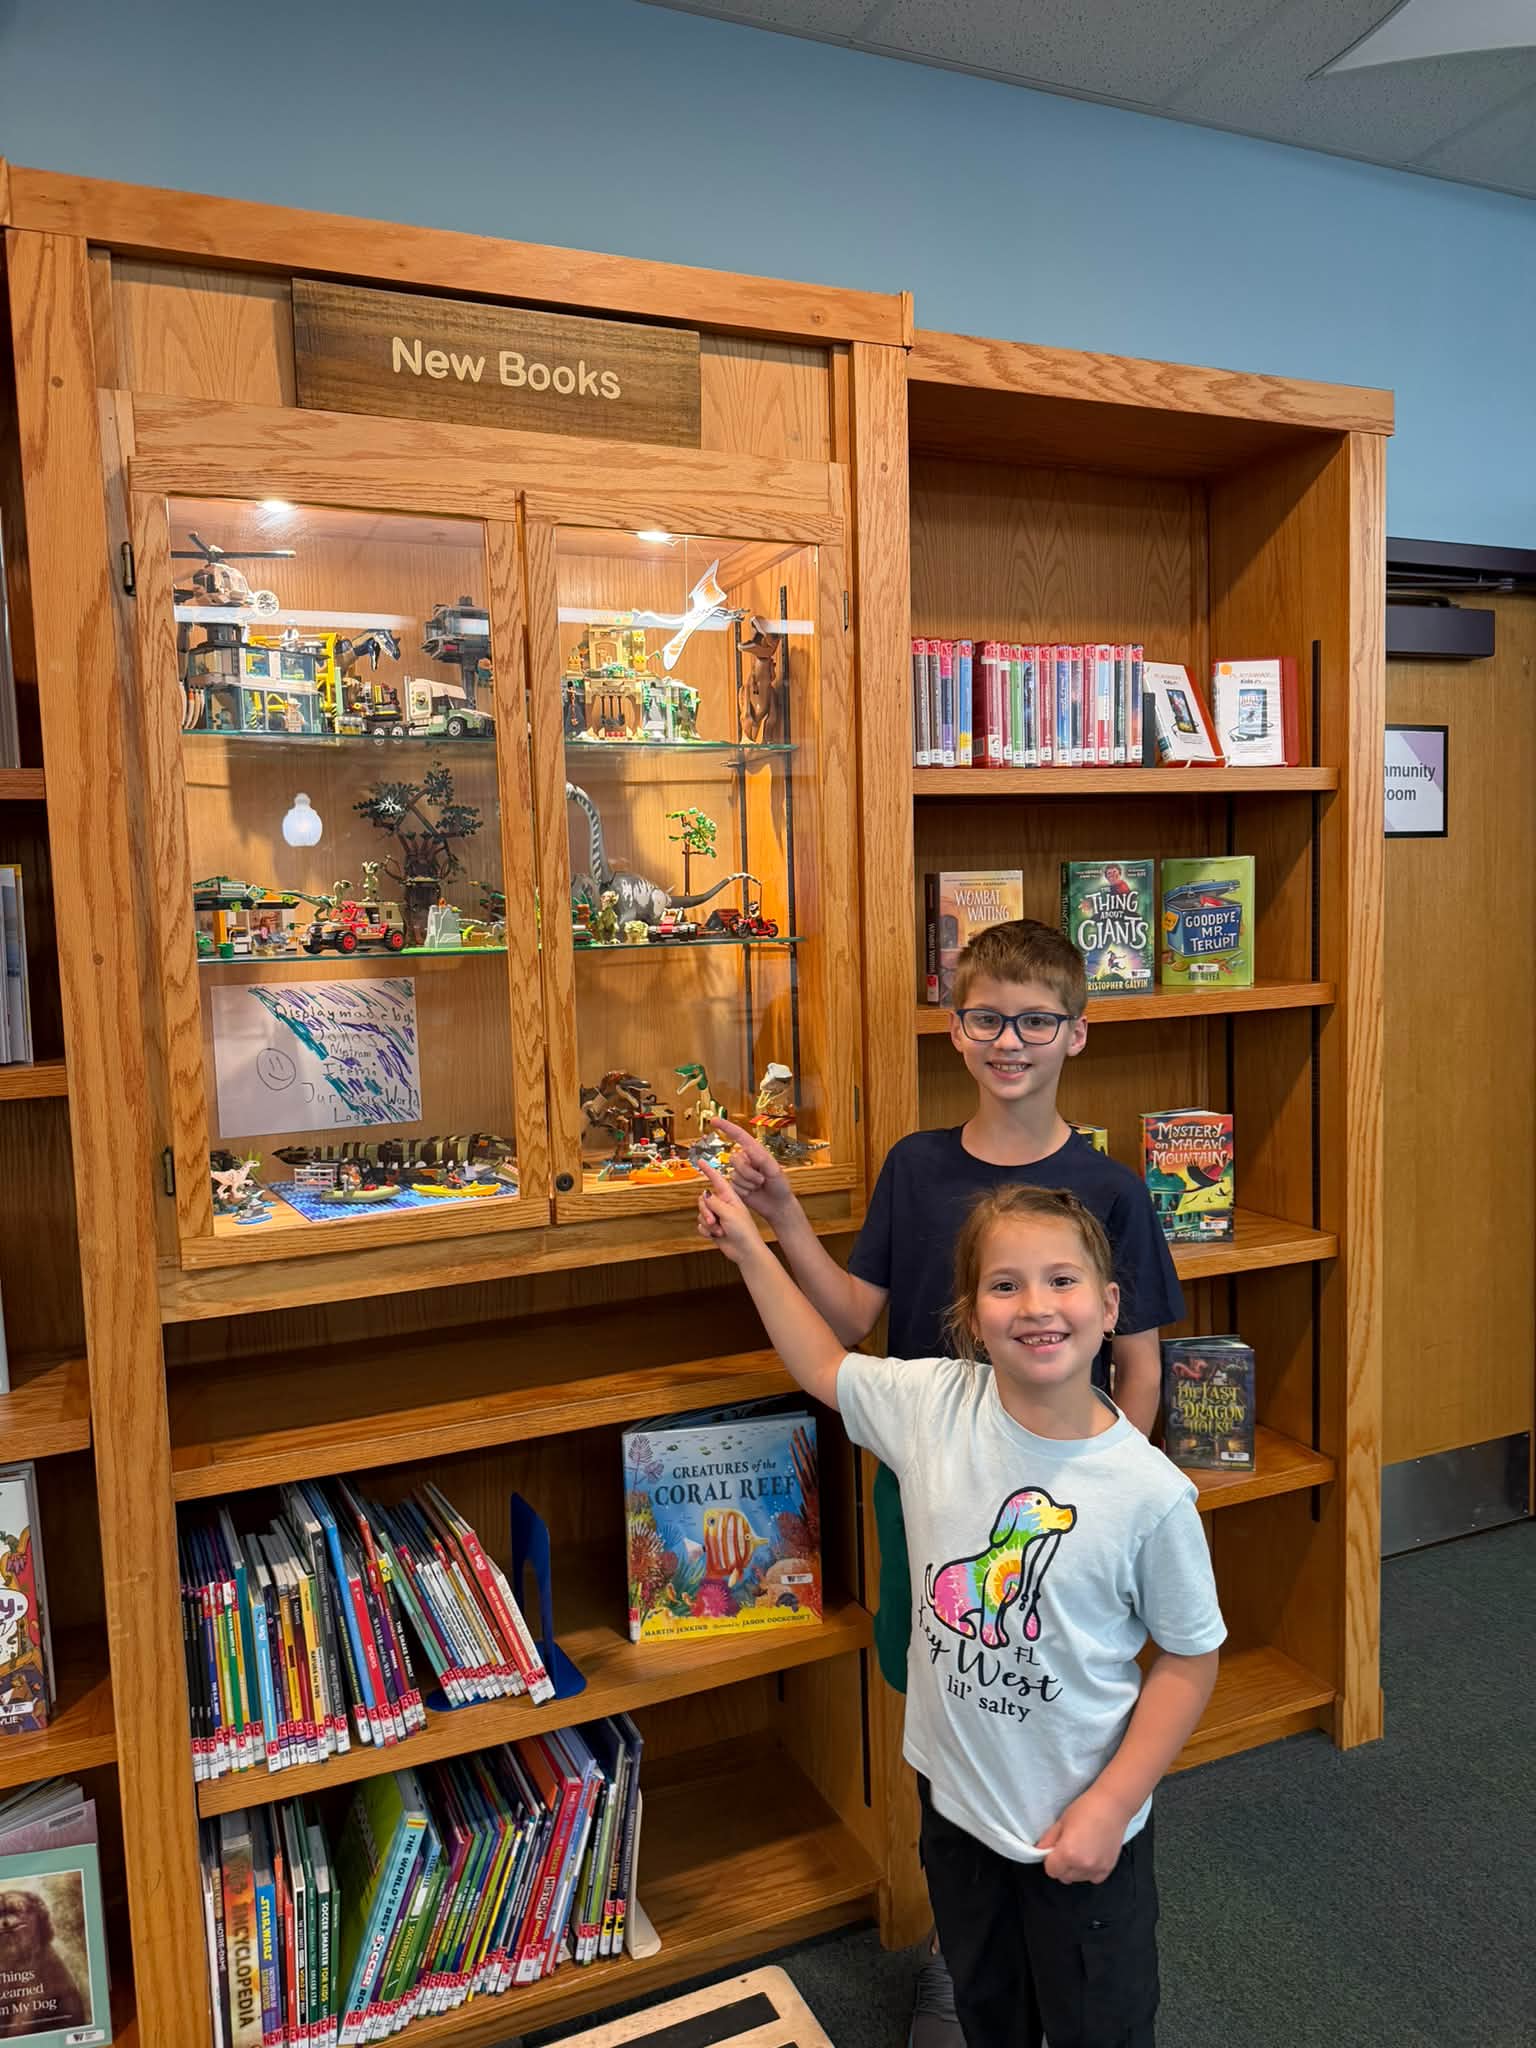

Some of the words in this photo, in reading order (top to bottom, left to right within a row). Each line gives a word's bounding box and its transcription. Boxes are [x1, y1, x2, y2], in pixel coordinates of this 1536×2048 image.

[392, 336, 485, 383] New
[499, 350, 621, 400] Books
[1384, 788, 1416, 801] oom
[954, 889, 1000, 906] WOMBAT
[1085, 891, 1138, 914] THING
[968, 905, 1009, 920] WAITING
[1100, 911, 1123, 920] ABOUT
[1185, 911, 1239, 928] GOODBYE,
[1078, 916, 1148, 950] GIANTS
[1190, 933, 1237, 952] TERUPT
[1087, 981, 1123, 991] RISTOPHER
[1157, 1122, 1224, 1139] MYSTERY
[1171, 1137, 1226, 1150] MACAW
[1152, 1150, 1228, 1168] MOUNTAIN
[1202, 1382, 1238, 1401] LAST
[1183, 1400, 1245, 1420] DRAGON
[673, 1460, 749, 1480] CREATURES
[751, 1459, 763, 1472] of
[763, 1458, 776, 1470] the
[655, 1479, 732, 1506] CORAL
[740, 1474, 795, 1500] REEF
[1013, 1646, 1040, 1665] FL
[958, 1639, 1063, 1702] West
[979, 1695, 1032, 1723] salty
[403, 1833, 417, 1855] THE
[387, 1856, 410, 1906] WORLD'S
[536, 1877, 554, 1919] HISTORY
[260, 1896, 271, 1929] STAR
[321, 1902, 329, 1931] SOCCER
[379, 1906, 393, 1933] BEST
[262, 1929, 272, 1961] WARS
[234, 1903, 254, 2029] ENCYCLOPEDIA
[321, 1968, 329, 1983] FOR
[321, 1984, 329, 2002] KIDS
[353, 1988, 368, 2012] BOO
[12, 2001, 29, 2016] My
[33, 1999, 57, 2011] Dog
[345, 2010, 366, 2027] NEW
[263, 2028, 283, 2046] NEW
